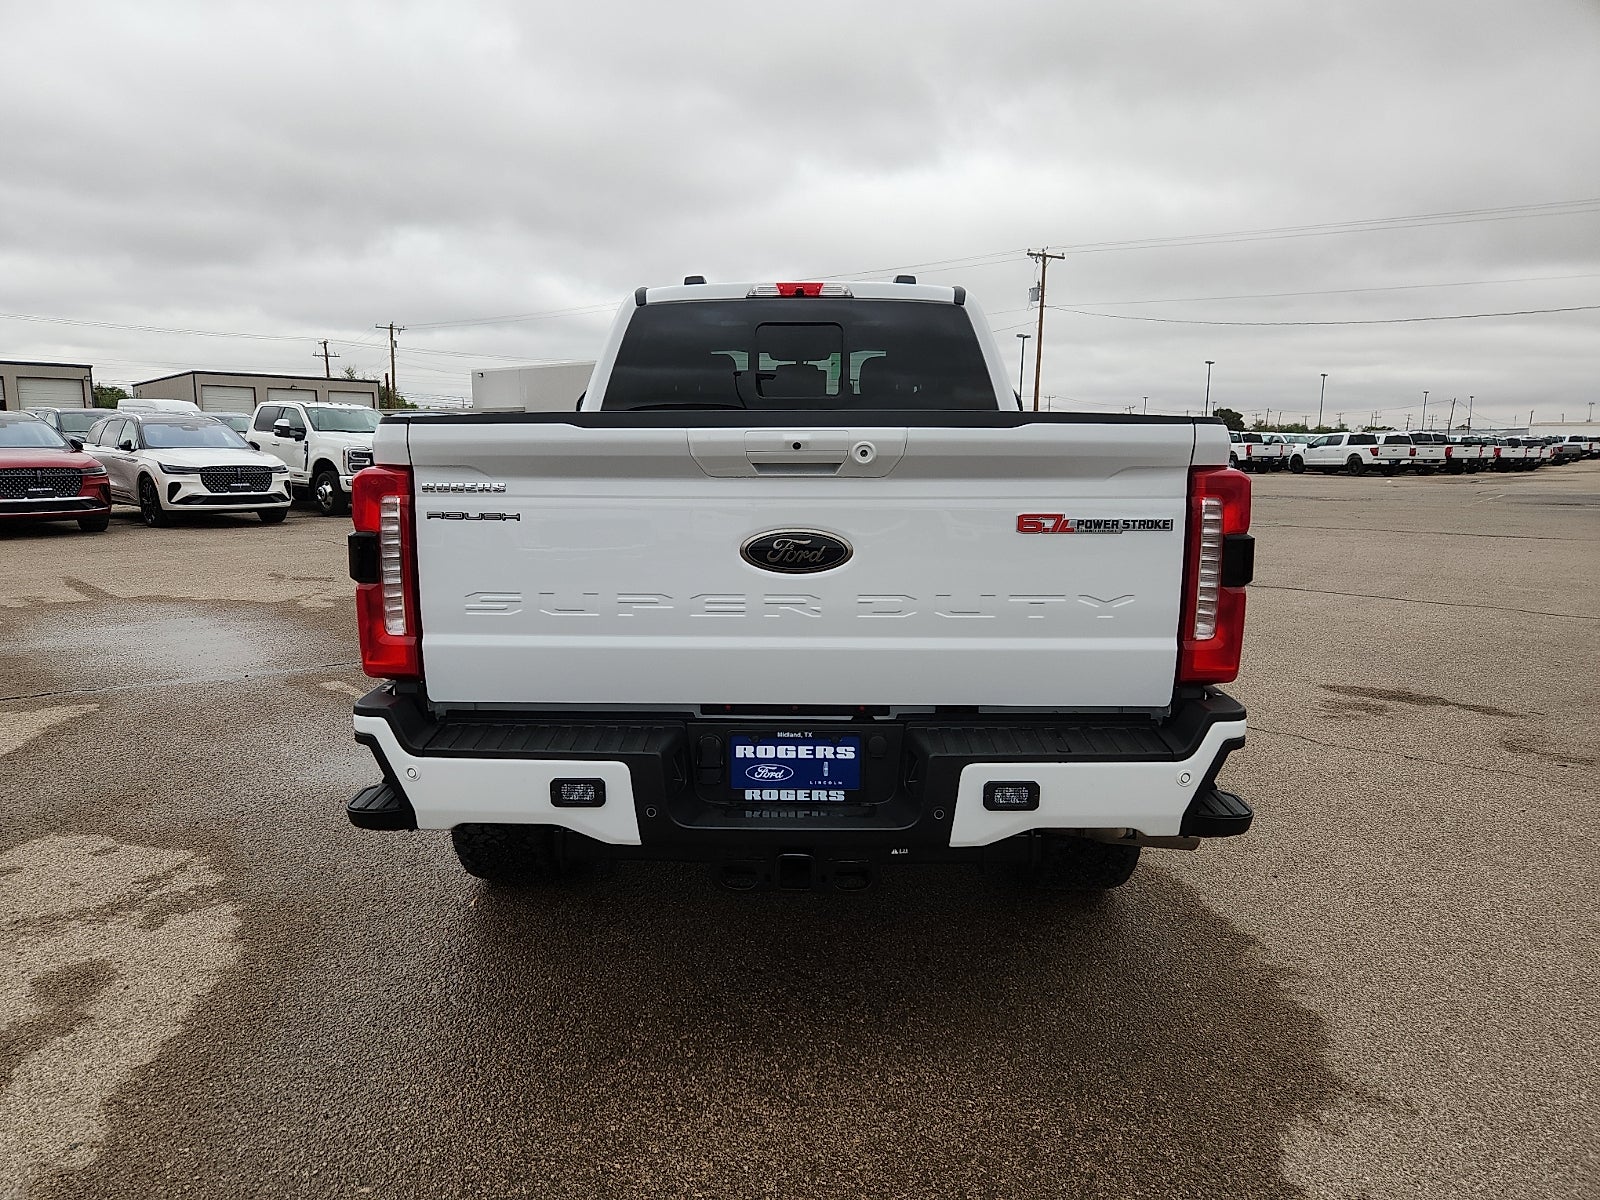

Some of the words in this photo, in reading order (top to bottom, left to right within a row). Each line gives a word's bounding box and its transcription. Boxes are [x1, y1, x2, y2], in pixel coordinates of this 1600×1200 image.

[421, 482, 506, 493] ROGERS
[427, 512, 520, 521] ROUSH
[1017, 513, 1075, 533] 6.7L
[1076, 519, 1119, 530] POWER
[1121, 519, 1171, 530] STROKE
[766, 538, 827, 562] Ford
[465, 591, 822, 617] SUPER
[856, 594, 1135, 618] DUTY
[735, 745, 856, 759] ROGERS
[754, 765, 785, 779] Ford
[744, 789, 845, 801] ROGERS
